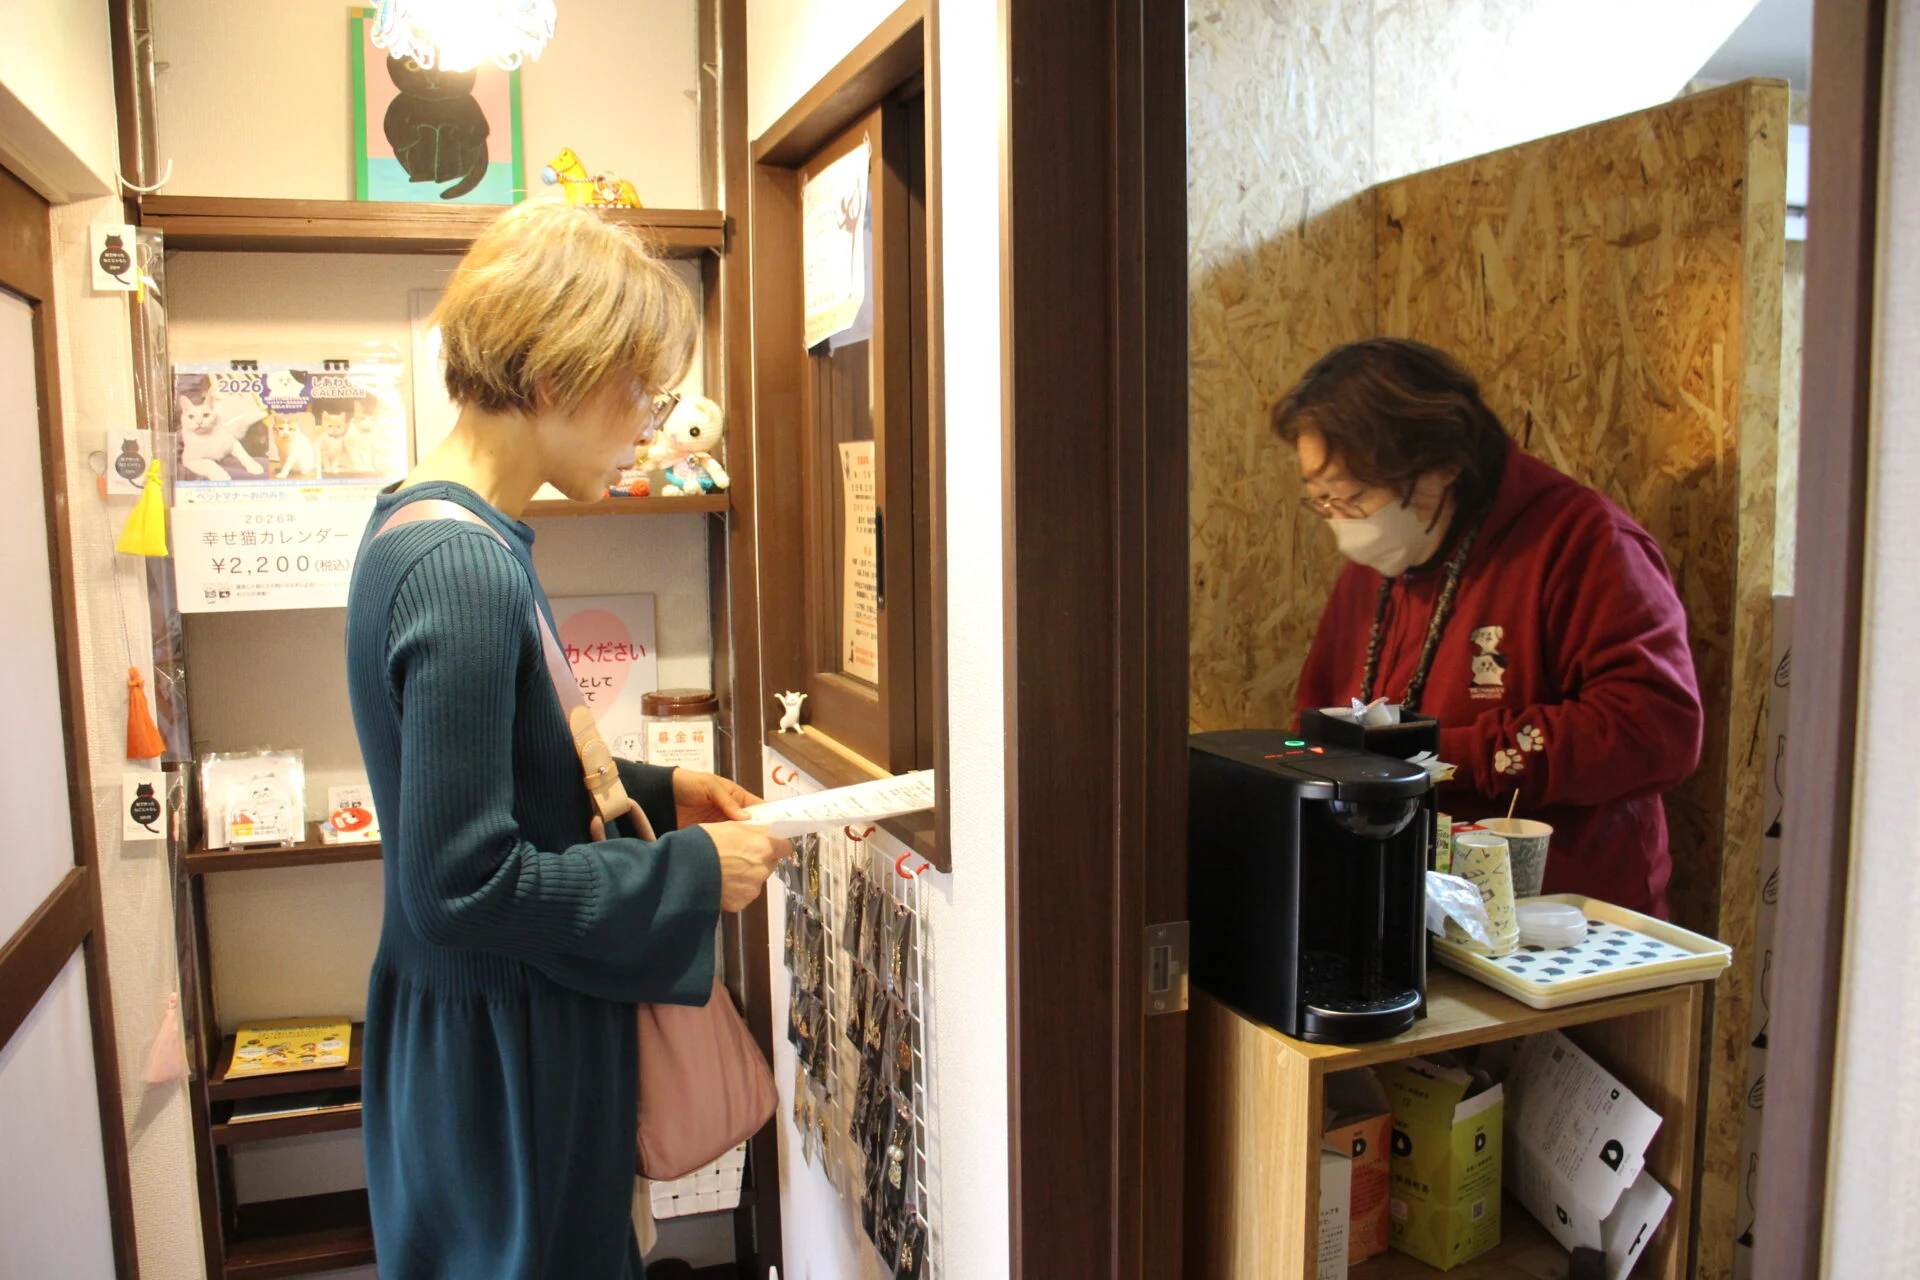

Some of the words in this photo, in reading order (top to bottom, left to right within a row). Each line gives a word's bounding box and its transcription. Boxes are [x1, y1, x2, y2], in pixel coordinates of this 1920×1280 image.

[219, 379, 262, 393] 2026
[310, 388, 366, 397] CALENDAR
[245, 514, 296, 524] 2026年
[203, 528, 349, 547] 幸せ猫カレンダー
[565, 641, 645, 664] 力ください
[657, 731, 704, 744] 募金箱
